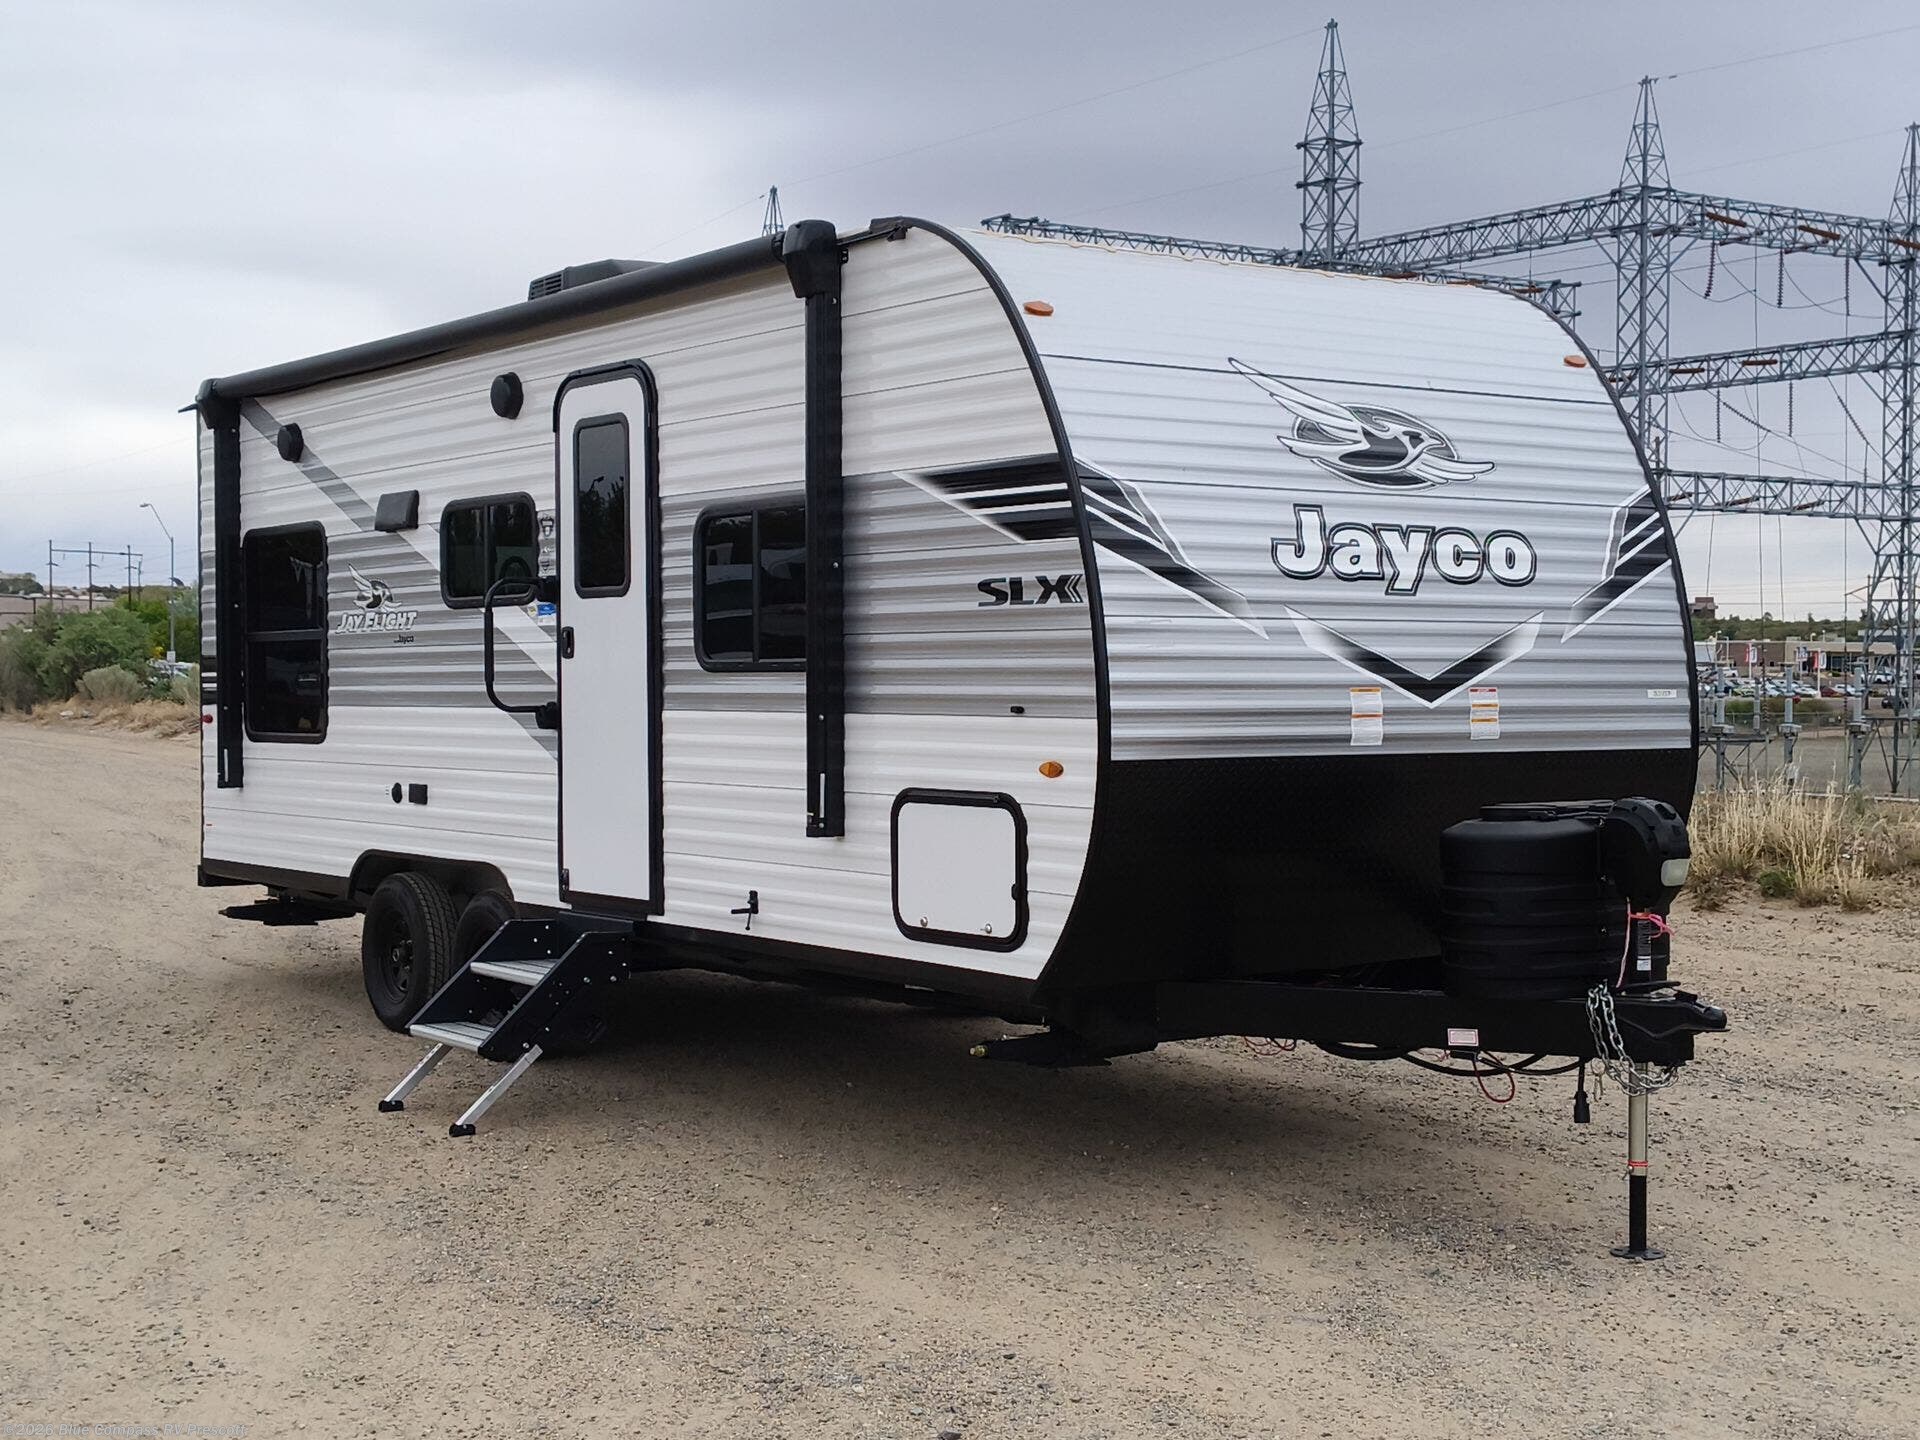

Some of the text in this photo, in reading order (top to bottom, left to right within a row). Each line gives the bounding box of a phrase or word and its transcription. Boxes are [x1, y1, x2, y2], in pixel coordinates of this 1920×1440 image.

[1271, 503, 1537, 596] Jayco
[977, 574, 1084, 607] SLX
[336, 611, 417, 634] JAY FLIGHT
